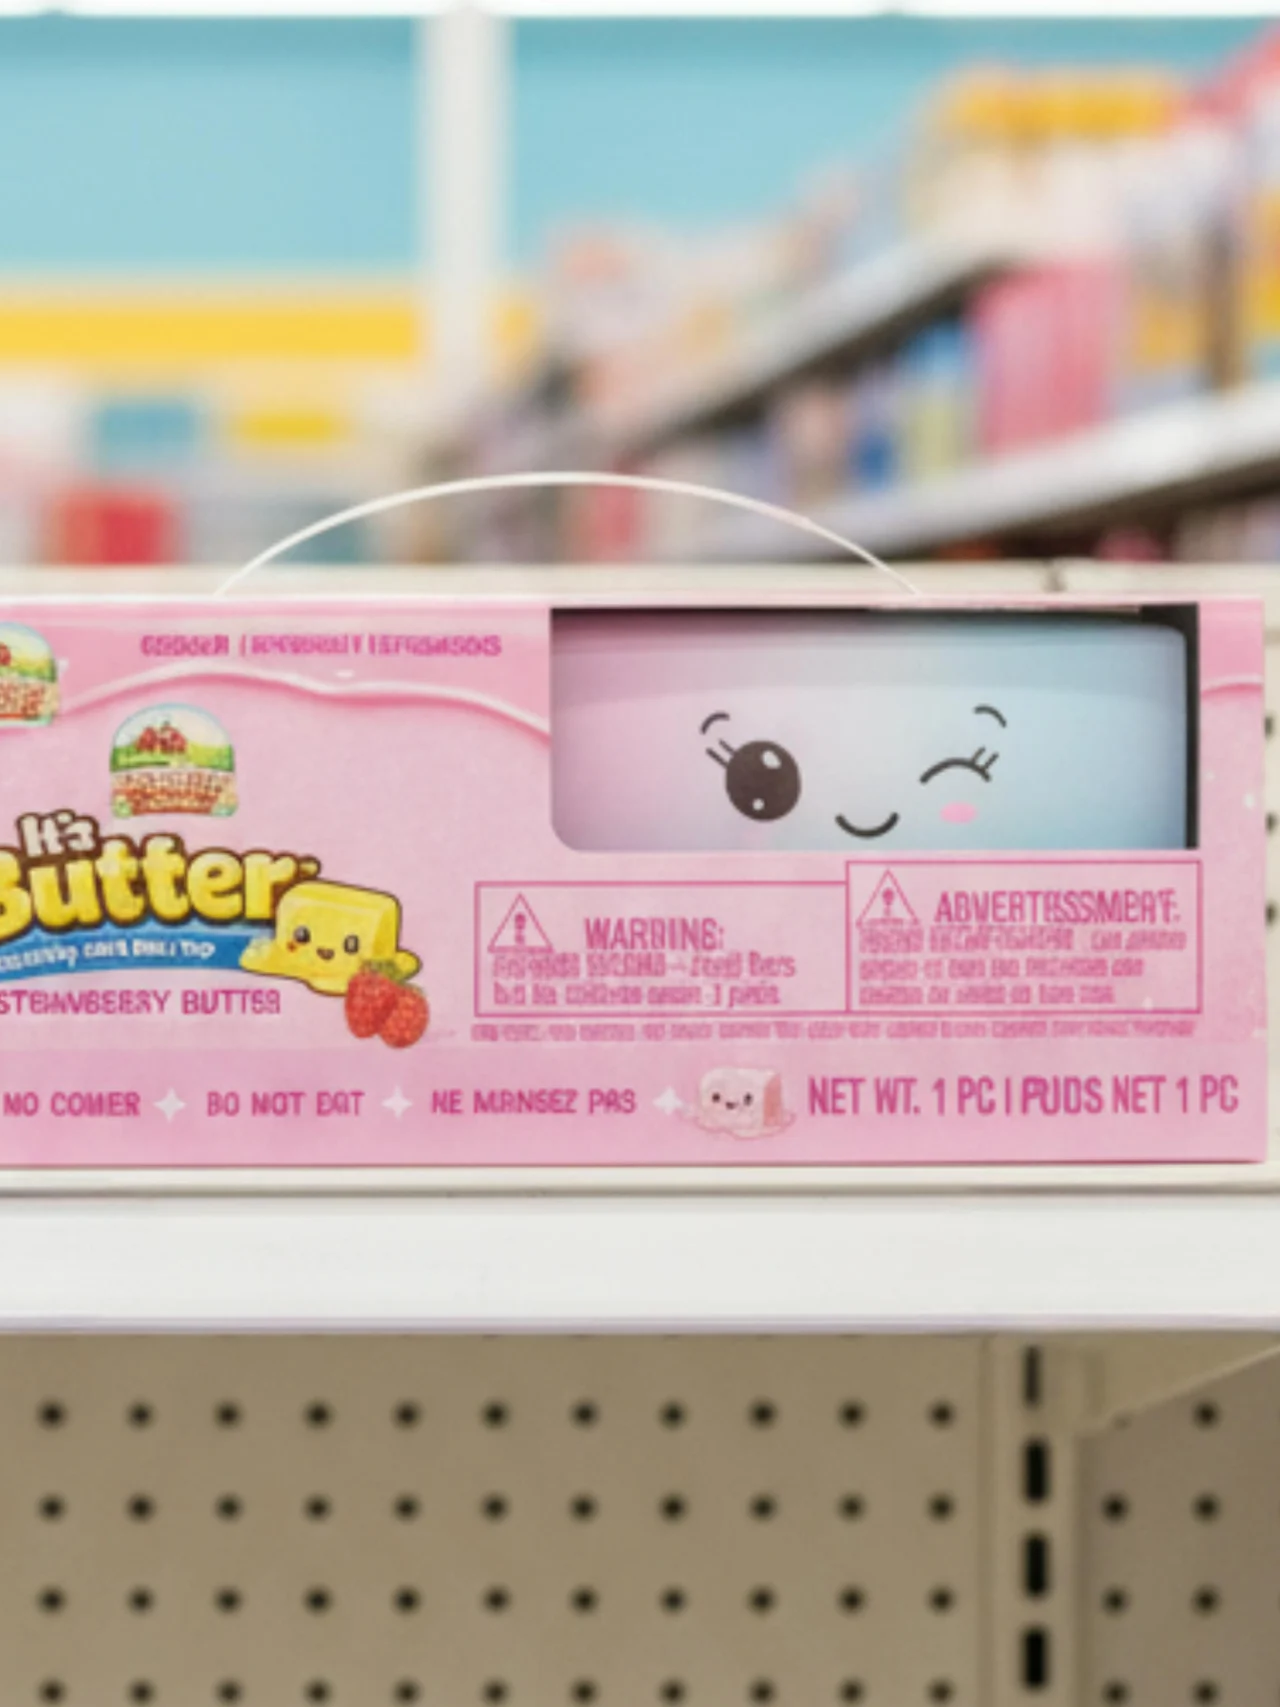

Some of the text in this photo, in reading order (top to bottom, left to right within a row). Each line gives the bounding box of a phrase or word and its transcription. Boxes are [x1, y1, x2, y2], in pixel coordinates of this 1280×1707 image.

[251, 1091, 306, 1117] NOT
[808, 1076, 866, 1115] NET
[874, 1076, 921, 1115] WT.
[931, 1077, 946, 1115] 1
[957, 1075, 996, 1115] PC
[1112, 1074, 1167, 1114] NET
[1176, 1076, 1189, 1114] 1
[1199, 1074, 1239, 1114] PC
